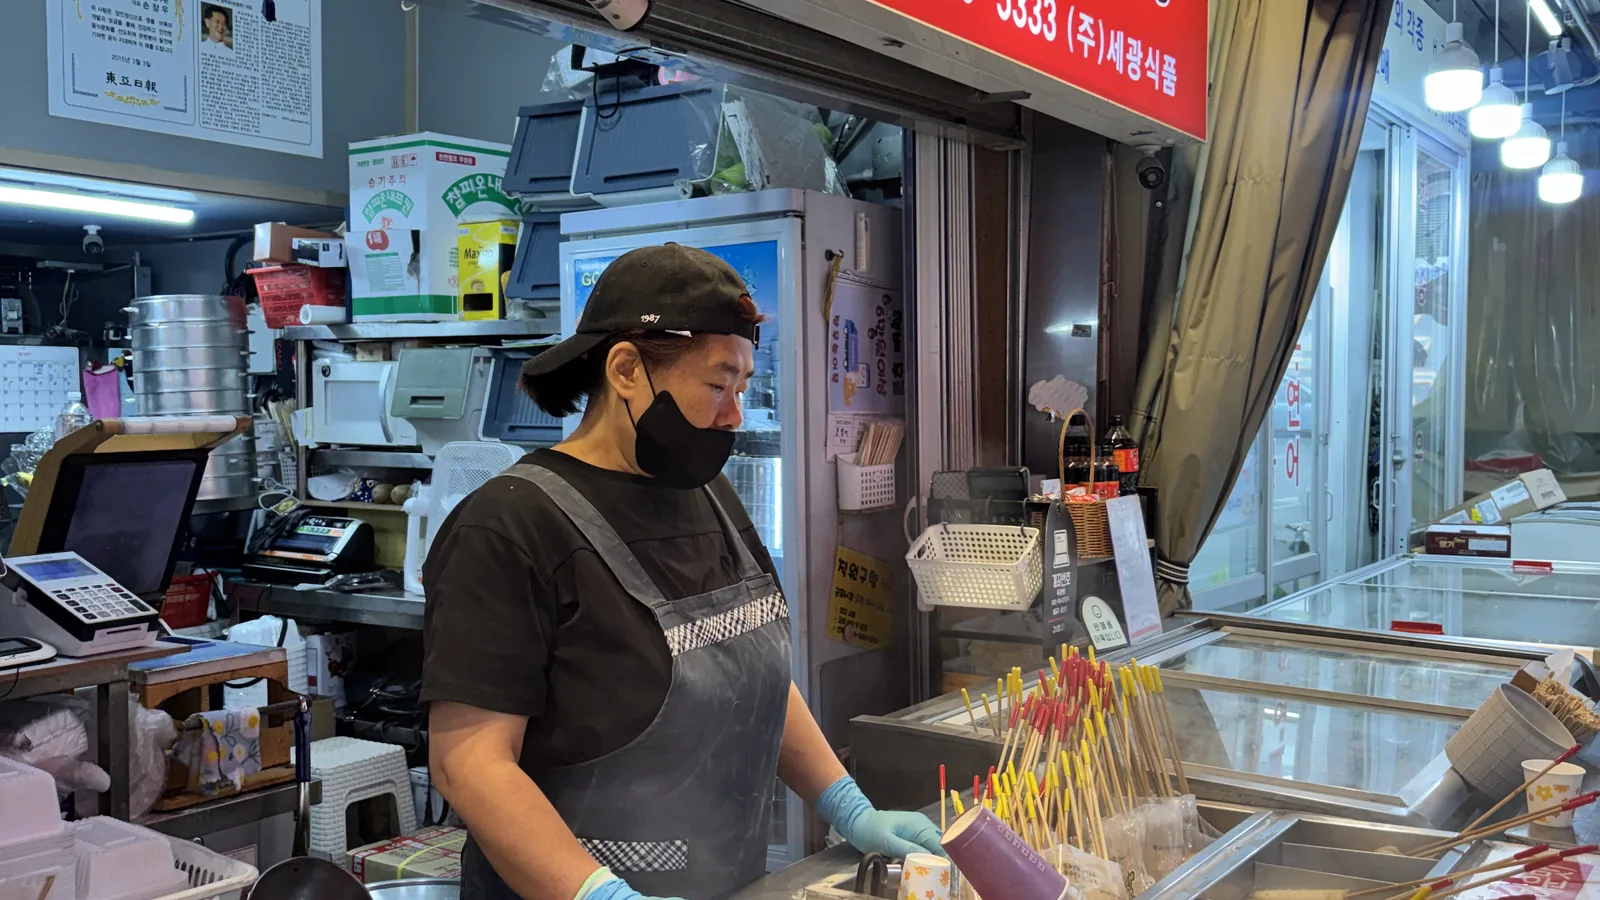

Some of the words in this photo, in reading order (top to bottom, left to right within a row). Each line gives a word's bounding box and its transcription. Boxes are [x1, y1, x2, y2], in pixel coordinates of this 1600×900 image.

[1067, 5, 1177, 97] (주)세광식품
[106, 71, 158, 93] 東亞日報
[640, 313, 661, 324] 1987
